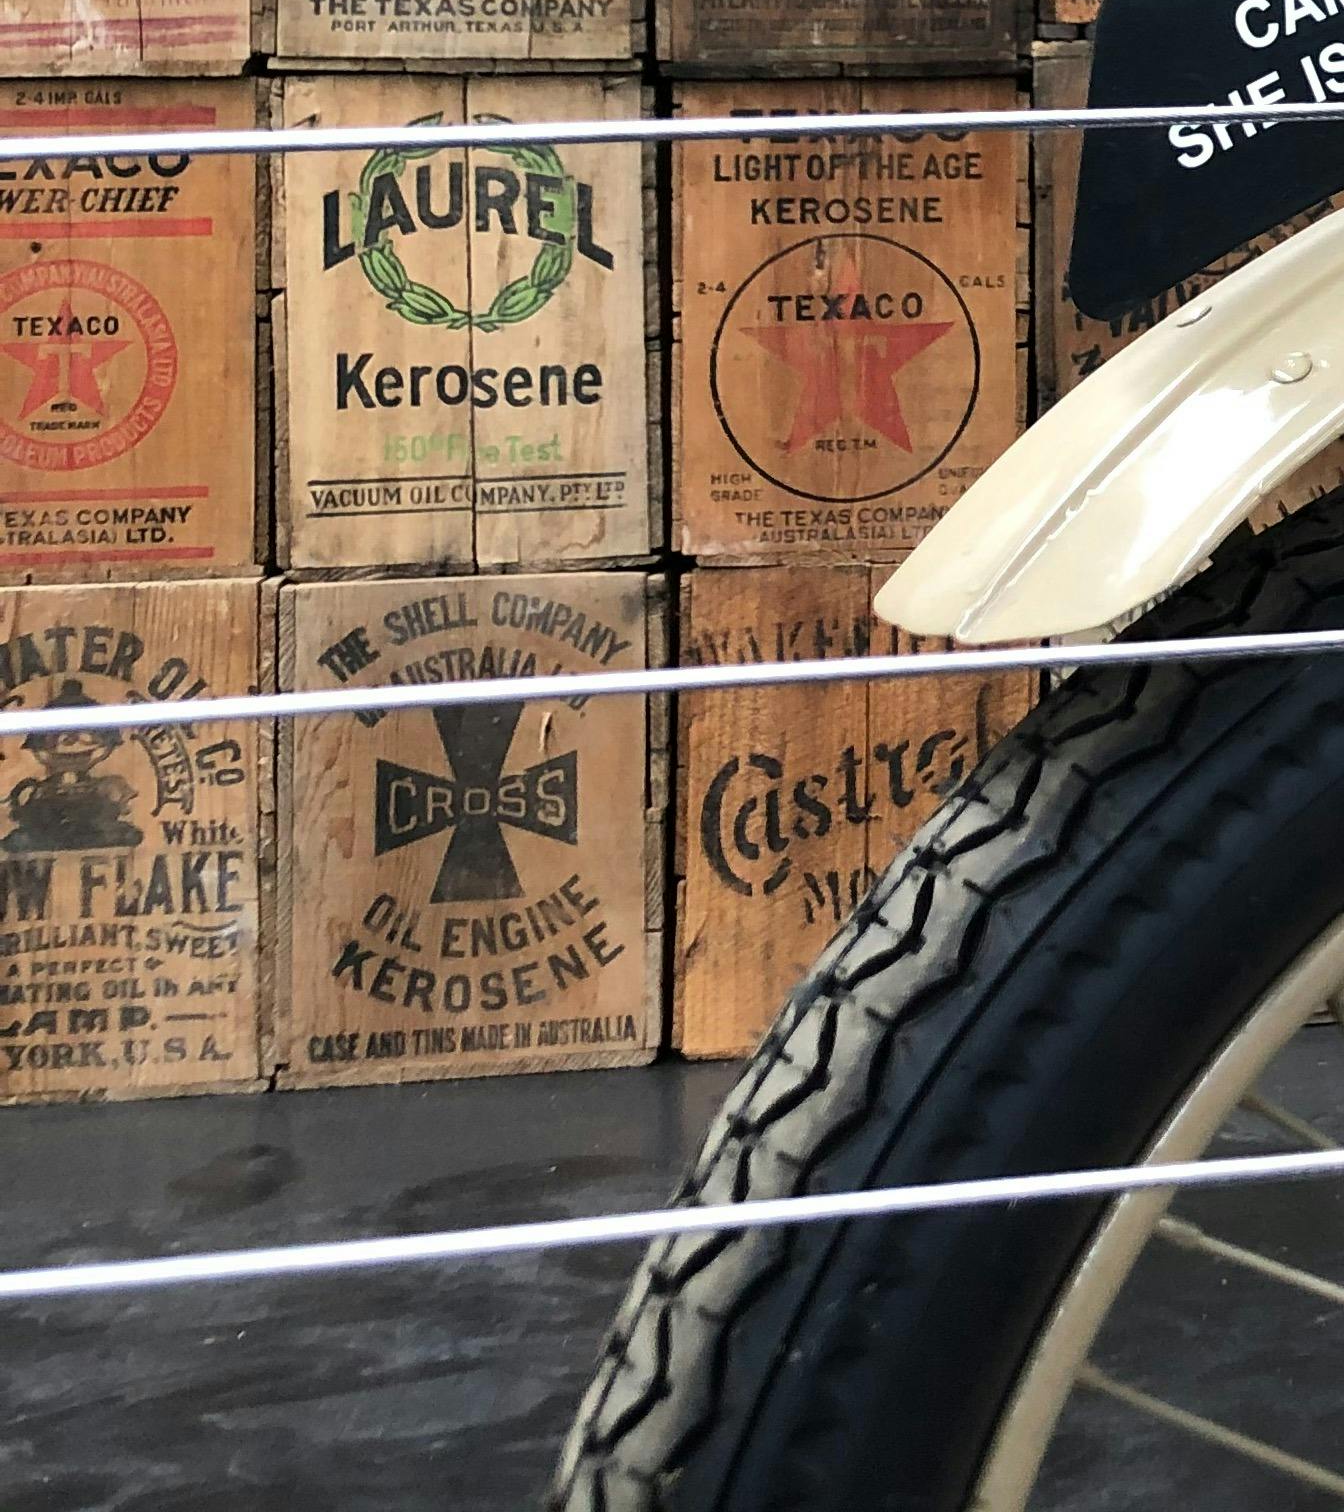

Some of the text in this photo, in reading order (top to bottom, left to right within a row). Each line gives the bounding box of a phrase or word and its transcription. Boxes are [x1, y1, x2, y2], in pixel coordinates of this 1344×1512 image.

[331, 19, 524, 34] PORT TEXAS
[1167, 69, 1286, 172] SHE
[713, 152, 984, 183] LIGHT OF THE AGE
[321, 163, 616, 272] LAUREL
[750, 197, 944, 225] KEROSENE
[768, 292, 924, 322] TEXACO
[12, 316, 120, 337] TEXACO
[335, 352, 604, 411] Kerosene
[710, 472, 753, 486] HIGH
[310, 486, 447, 511] VACUUM OIL
[710, 488, 763, 503] GRADE
[76, 504, 192, 526] COMPANY
[735, 510, 851, 528] THE TEXAS
[125, 526, 175, 544] LTD.
[317, 589, 633, 683] THE SHELL COMPANY
[389, 767, 568, 835] CROSS
[162, 819, 244, 846] White
[80, 851, 244, 919] FLAKE
[363, 872, 600, 961] OIL ENGINE
[145, 926, 240, 960] SWEET
[31, 956, 137, 976] PERFECT
[330, 920, 628, 1016] KEROSENE
[102, 978, 147, 1000] OIL
[308, 1014, 638, 1064] CASE AND TINS MADE IN AUSTRALIA
